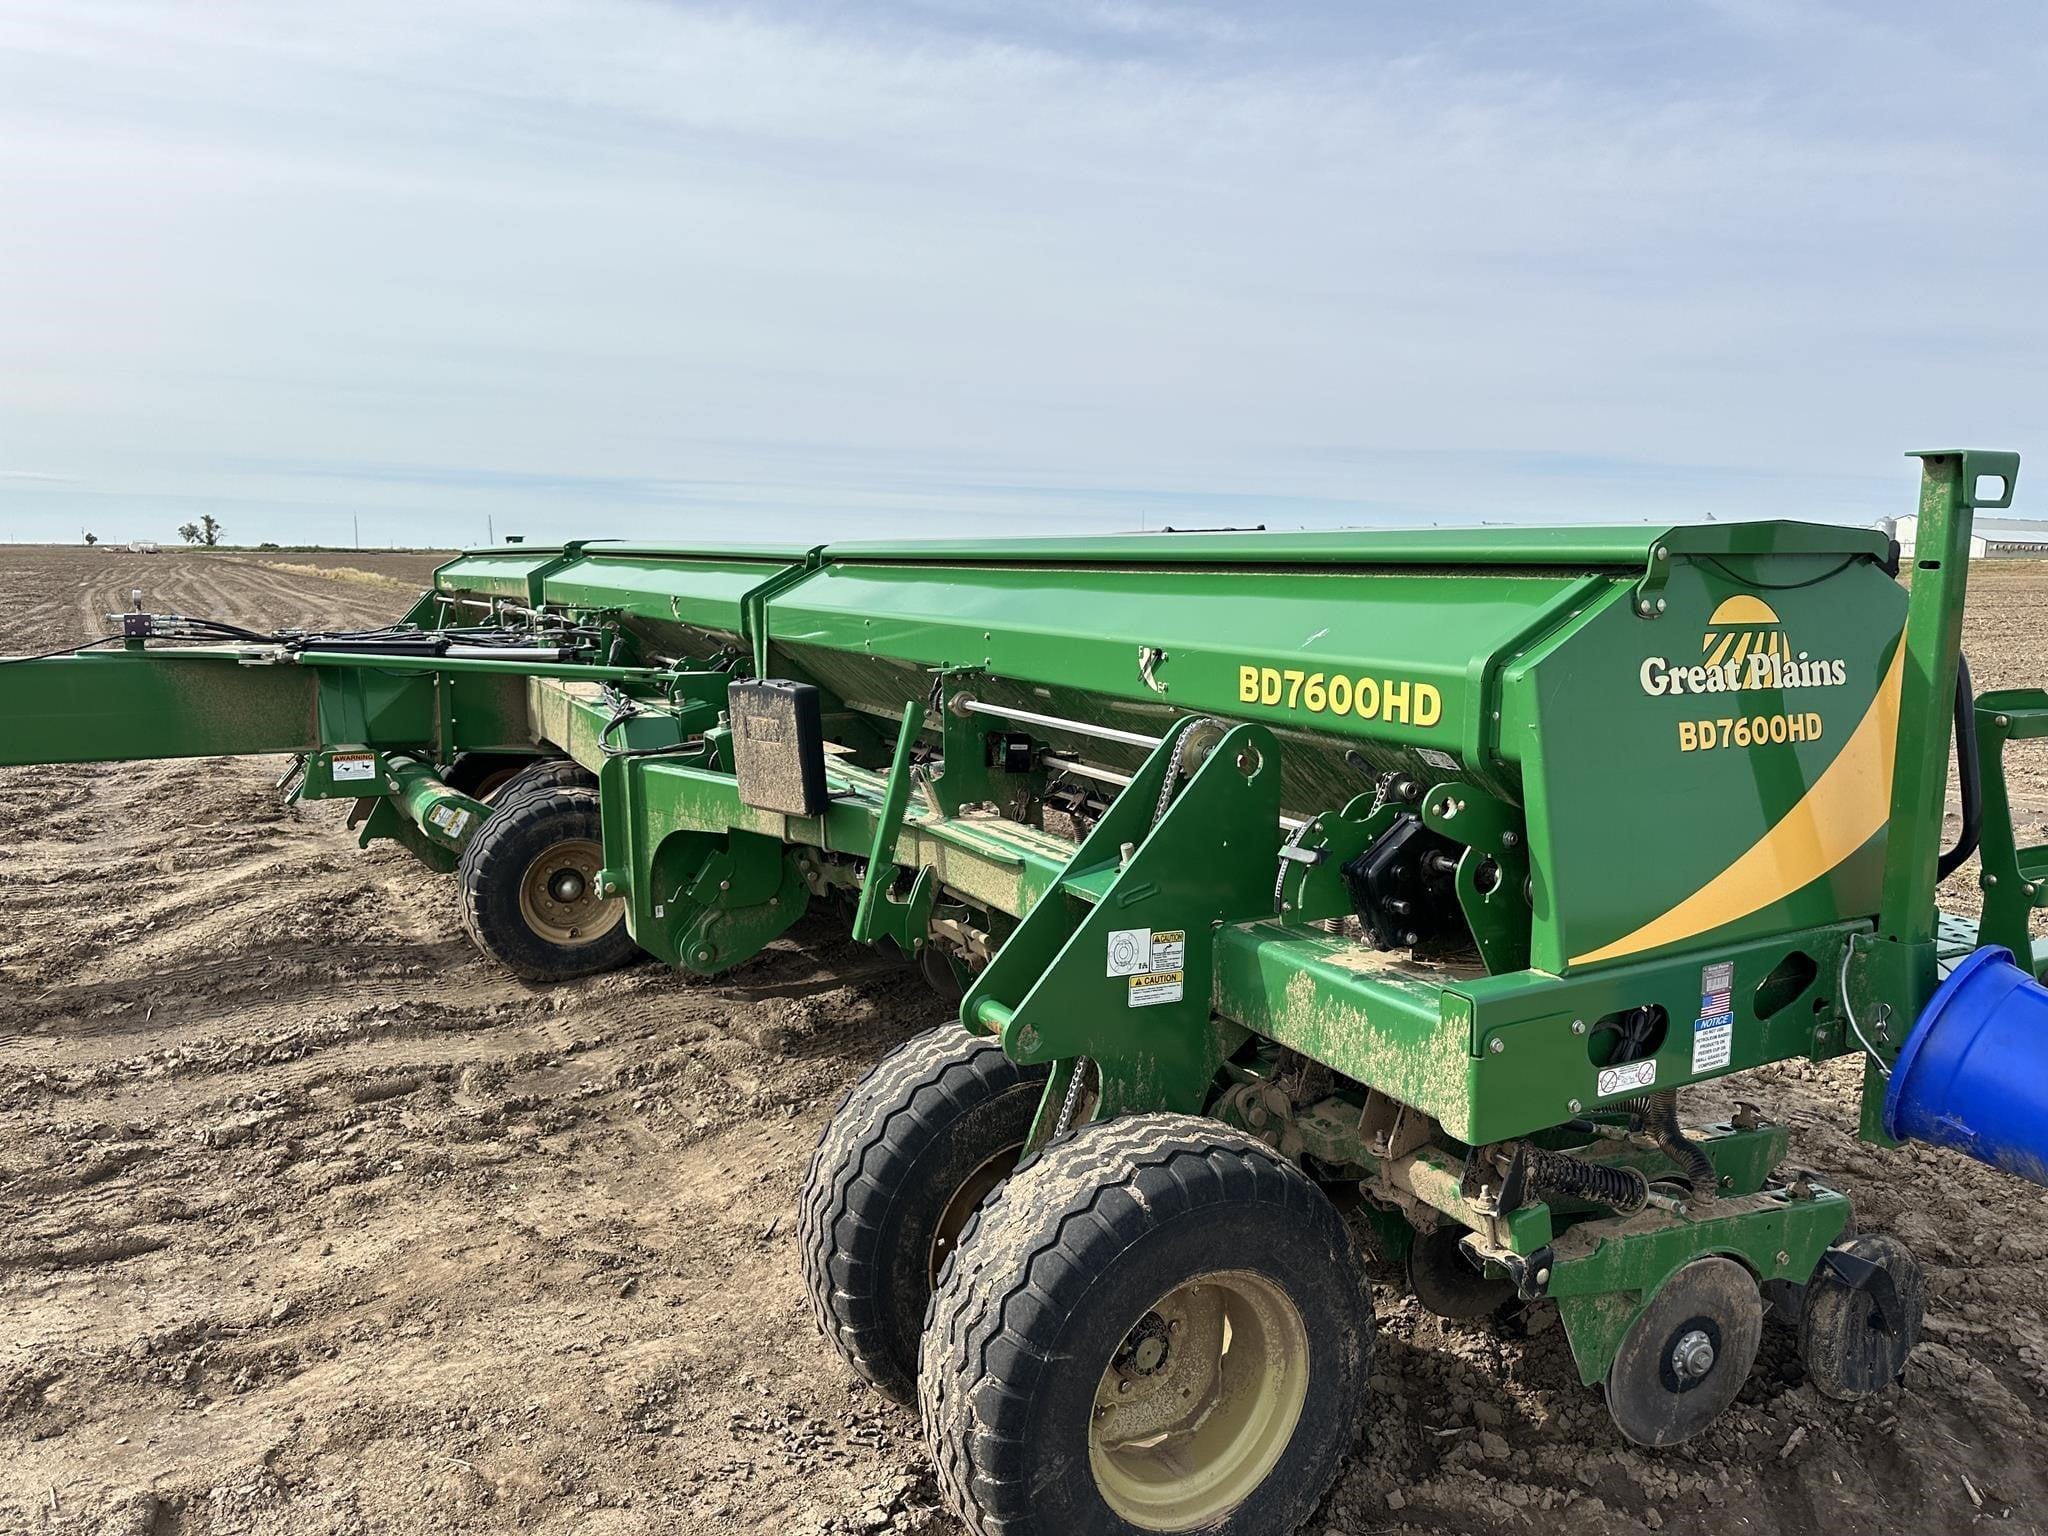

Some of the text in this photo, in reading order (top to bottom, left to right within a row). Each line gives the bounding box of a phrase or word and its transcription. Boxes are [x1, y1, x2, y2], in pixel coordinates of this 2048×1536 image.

[1640, 652, 1846, 696] Great Plains
[1239, 665, 1442, 727] BD7600HD
[1678, 712, 1823, 752] BD7600HD
[1160, 933, 1183, 943] CAUTION
[1144, 974, 1177, 985] CAUTION
[1700, 1015, 1730, 1029] NOTICE
